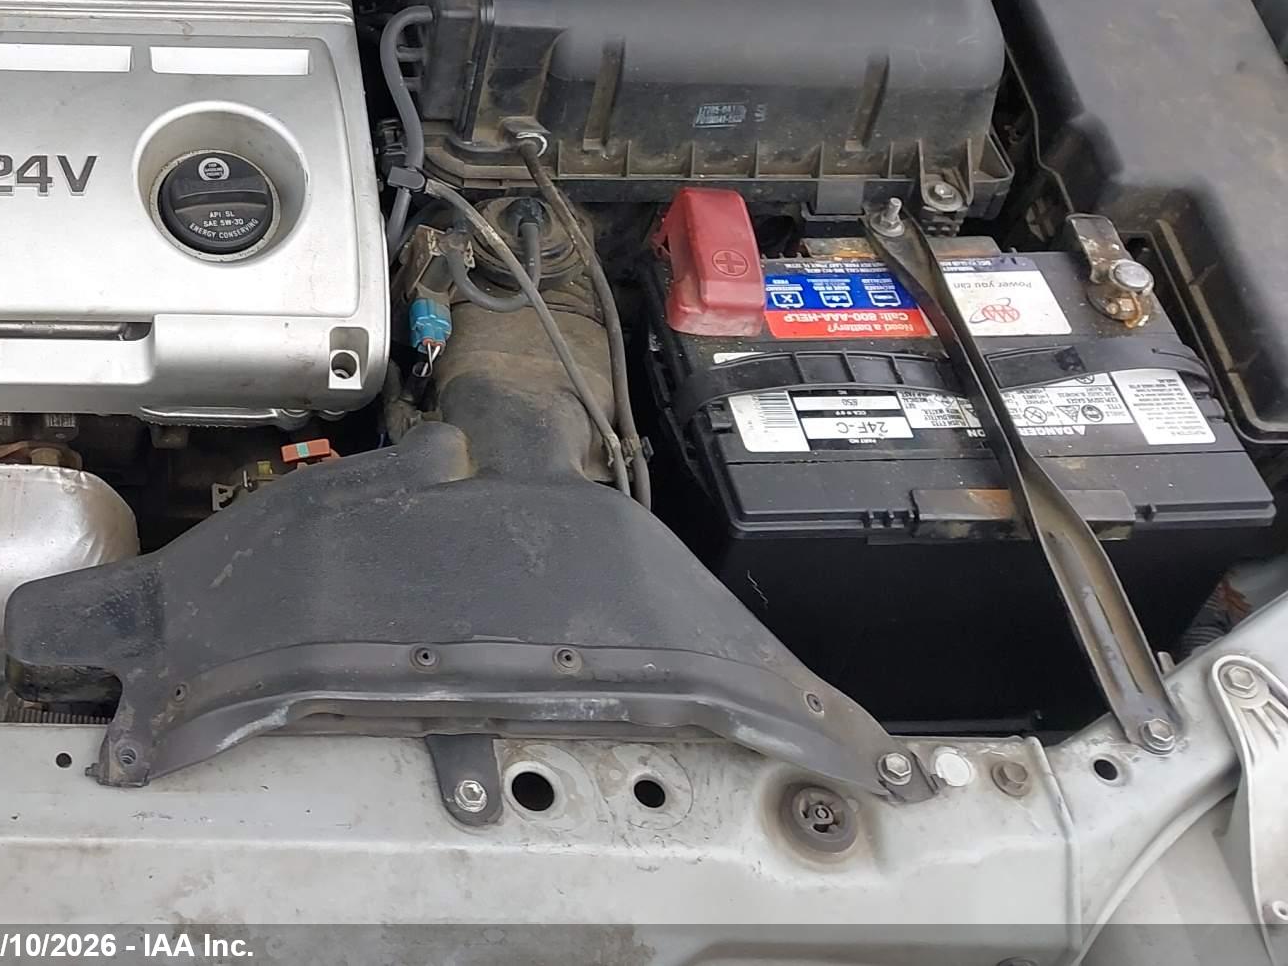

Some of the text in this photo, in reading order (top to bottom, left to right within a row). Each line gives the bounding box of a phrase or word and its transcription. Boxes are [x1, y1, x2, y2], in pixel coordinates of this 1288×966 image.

[225, 210, 235, 218] SL
[203, 218, 244, 228] SAE 5W-30
[189, 218, 259, 239] ENERGY CONSERVING
[953, 280, 1032, 289] Power you can
[783, 312, 909, 323] Call: 800-AAA-HELP
[827, 323, 873, 333] battery?
[836, 421, 889, 434] 24F-C
[1019, 426, 1073, 436] DANGER
